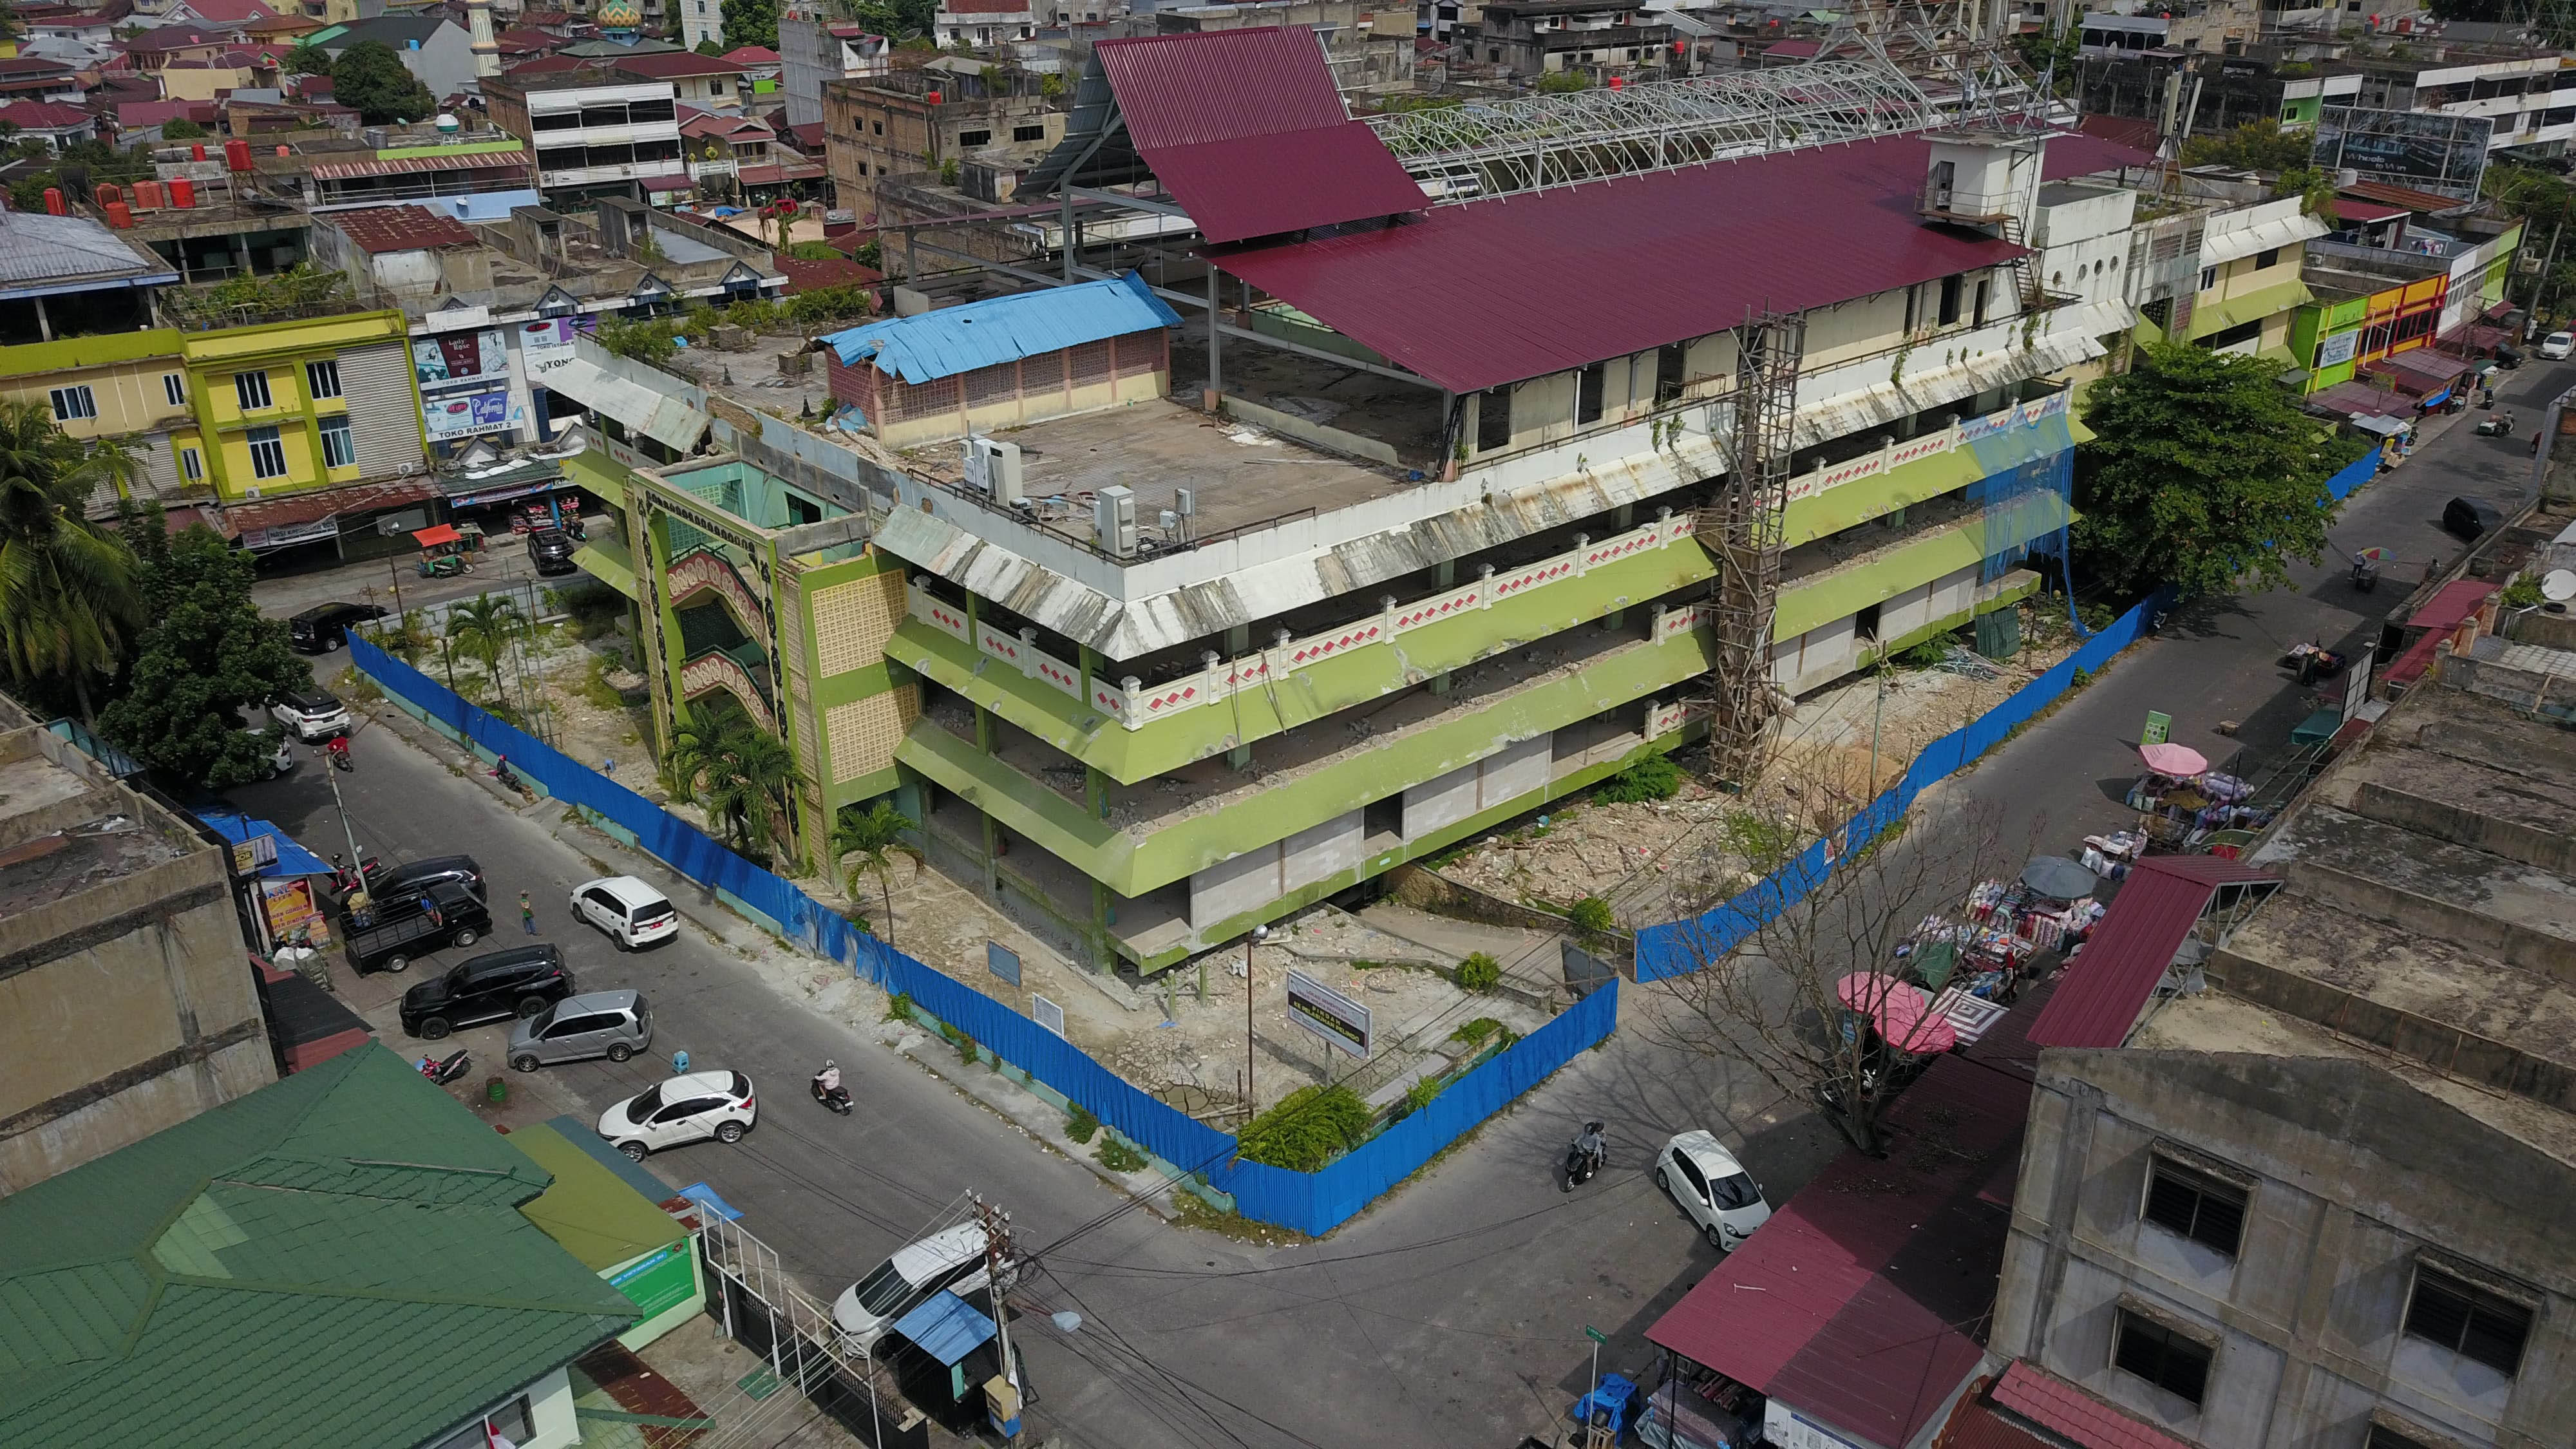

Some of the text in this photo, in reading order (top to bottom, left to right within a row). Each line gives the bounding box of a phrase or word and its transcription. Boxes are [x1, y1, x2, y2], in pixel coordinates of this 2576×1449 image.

[472, 398, 503, 418] California
[439, 430, 464, 439] TOKO
[467, 423, 503, 434] RAHMAT
